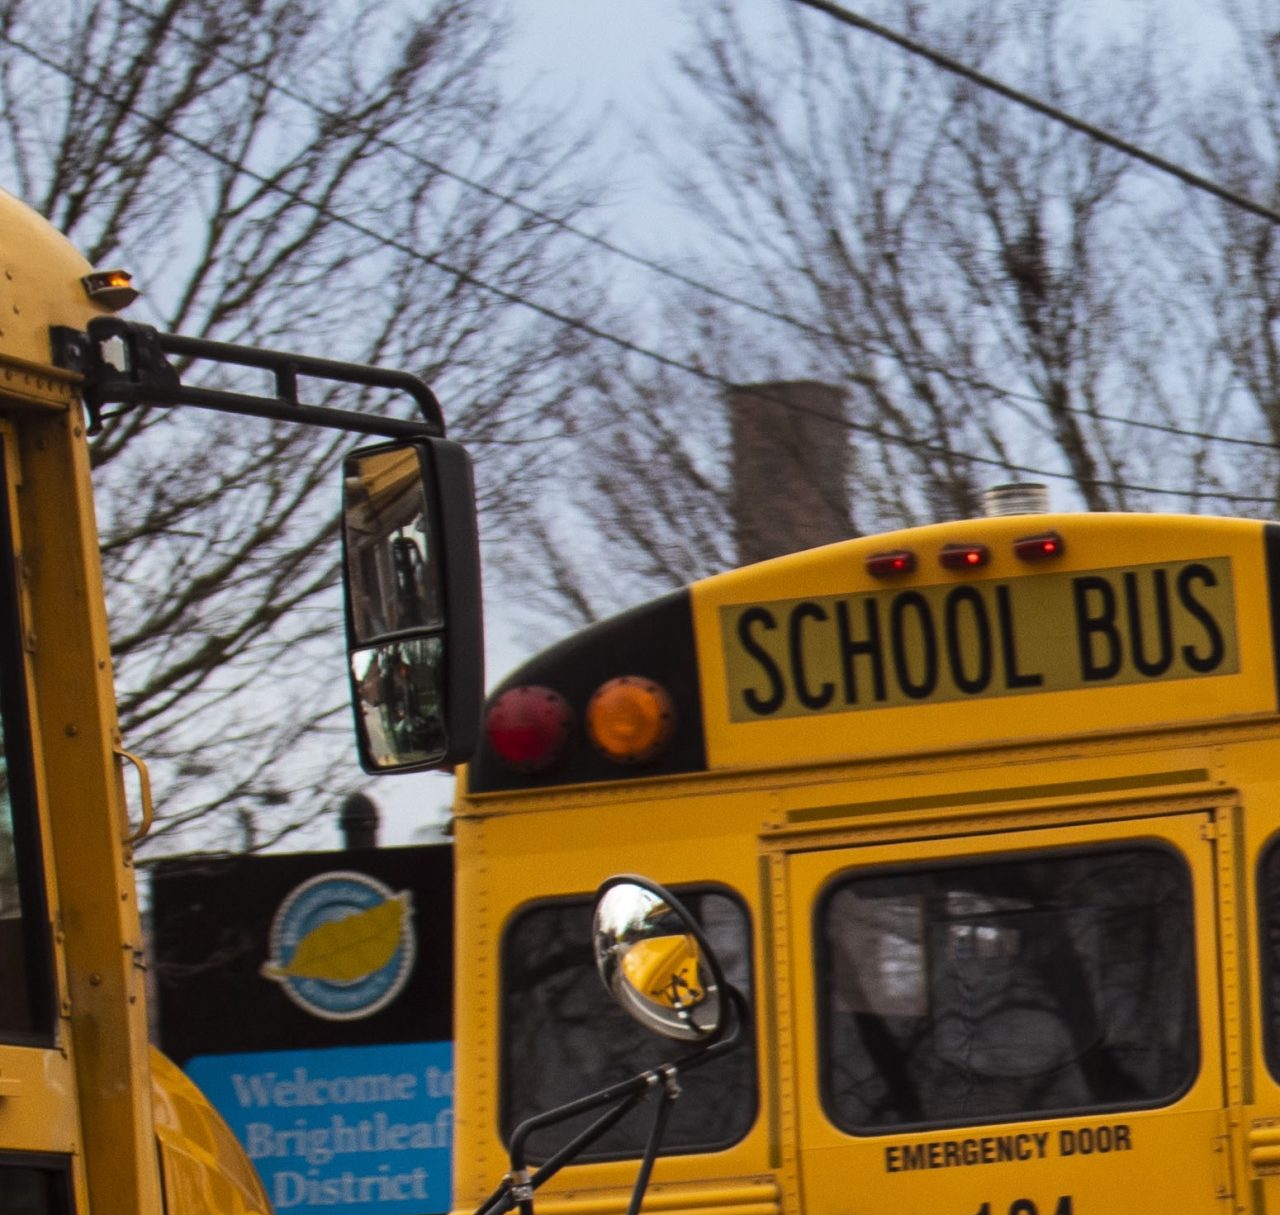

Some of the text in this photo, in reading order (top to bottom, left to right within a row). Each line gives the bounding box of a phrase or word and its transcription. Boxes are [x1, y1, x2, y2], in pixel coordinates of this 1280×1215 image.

[737, 563, 1226, 715] SCHOOL BUS
[231, 1067, 416, 1107] Welcome
[247, 1108, 453, 1165] Brightleaf
[884, 1125, 1132, 1173] EMERGENCY DOOR
[273, 1164, 428, 1208] District
